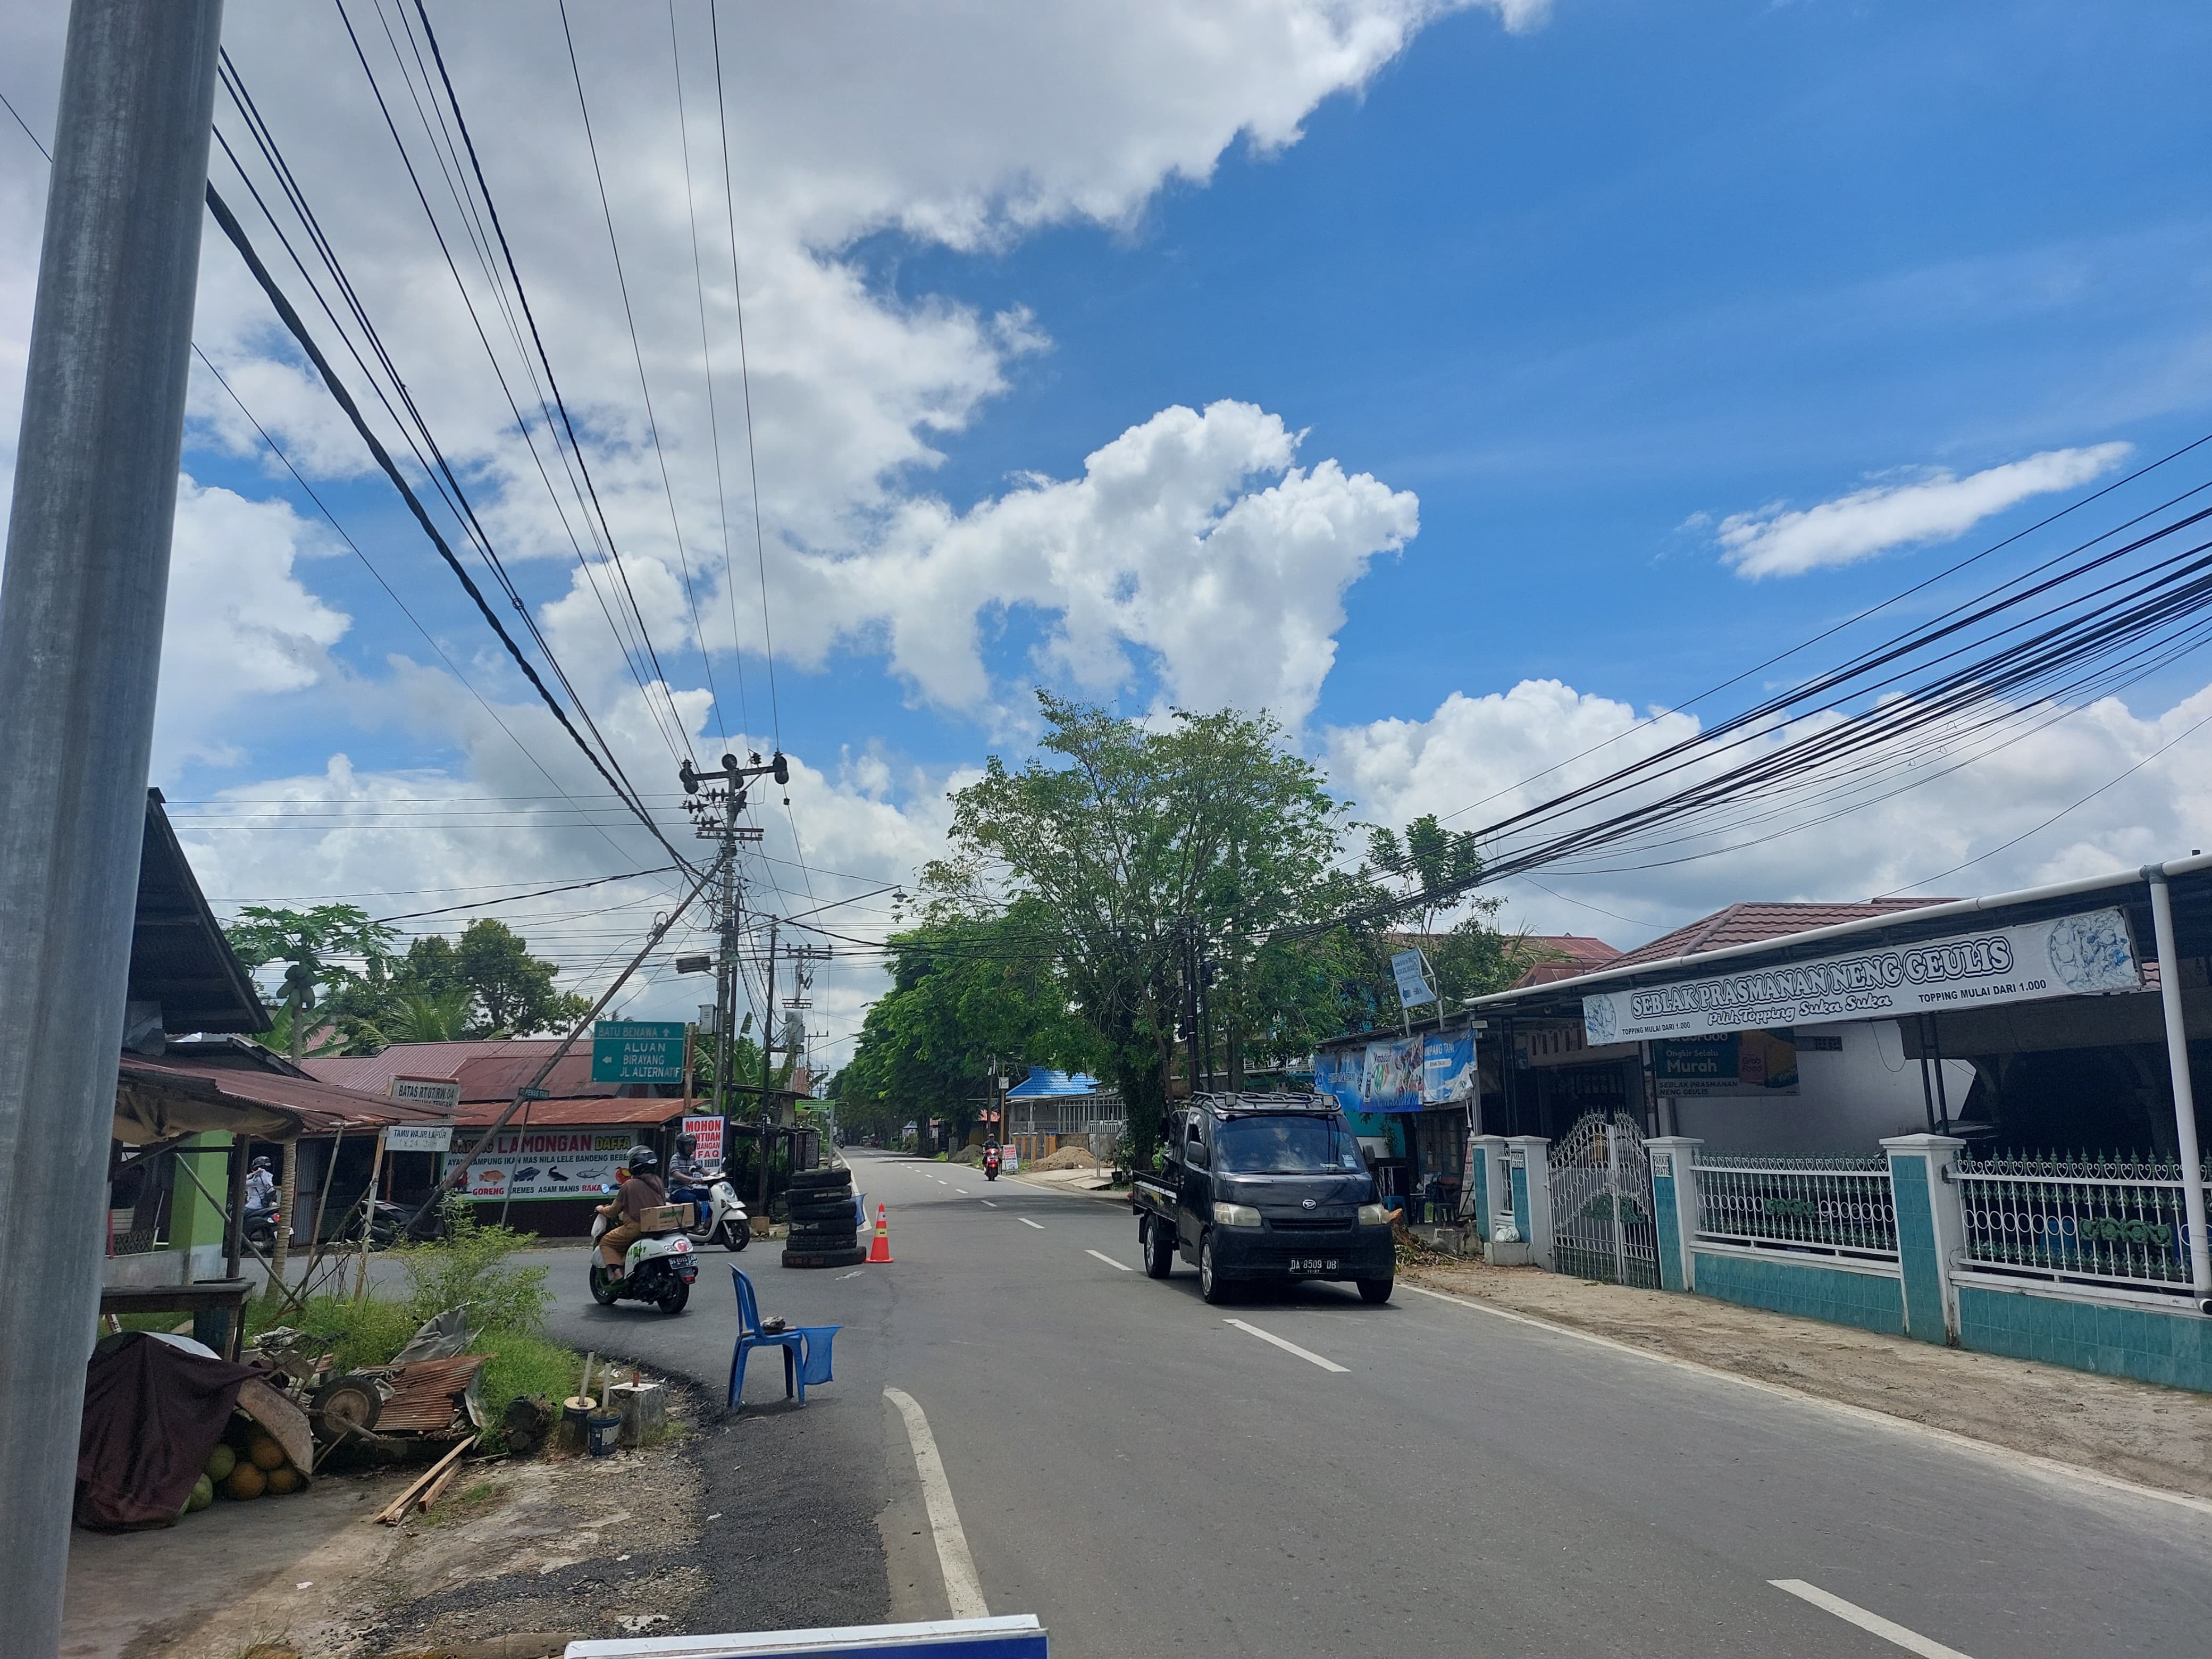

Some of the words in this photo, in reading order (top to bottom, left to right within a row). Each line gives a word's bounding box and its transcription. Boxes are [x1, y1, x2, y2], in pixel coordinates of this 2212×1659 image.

[1631, 985, 1699, 1019] SEBLAK
[1697, 963, 1829, 1011] PRASMANAN
[1827, 952, 1903, 995] NENG
[1902, 936, 2014, 984] GEULIS
[1918, 991, 1958, 1003] TOPPING
[1960, 987, 1990, 999] MULAI
[1993, 984, 2016, 994] DARI
[2020, 979, 2047, 992] 1.000
[1739, 1007, 1795, 1024] Topping
[1799, 999, 1843, 1016] Suka
[1845, 992, 1892, 1011] Suka
[598, 1027, 620, 1037] BATU
[623, 1027, 657, 1037] BENAWA
[1622, 1027, 1644, 1036] TOPPING
[1645, 1025, 1661, 1033] MULAI
[624, 1043, 666, 1052] ALUAN
[1666, 1050, 1691, 1059] Ongkir
[623, 1055, 664, 1065] BIRAYANG
[1667, 1059, 1717, 1074] Murah
[632, 1067, 681, 1077] ALTERNATIF
[399, 1085, 418, 1097] BATAS
[419, 1087, 428, 1099] RT
[685, 1119, 721, 1132] MOHON
[451, 1139, 494, 1154] WARG
[498, 1134, 591, 1154] LAMONGAN
[595, 1136, 631, 1150] DAFFA
[471, 1157, 502, 1166] AMPUNG
[1654, 1166, 1671, 1176] GRATIS
[473, 1187, 504, 1196] GORENG
[1291, 1260, 1300, 1269] DA
[1303, 1259, 1322, 1269] 8509
[1327, 1260, 1337, 1269] DB
